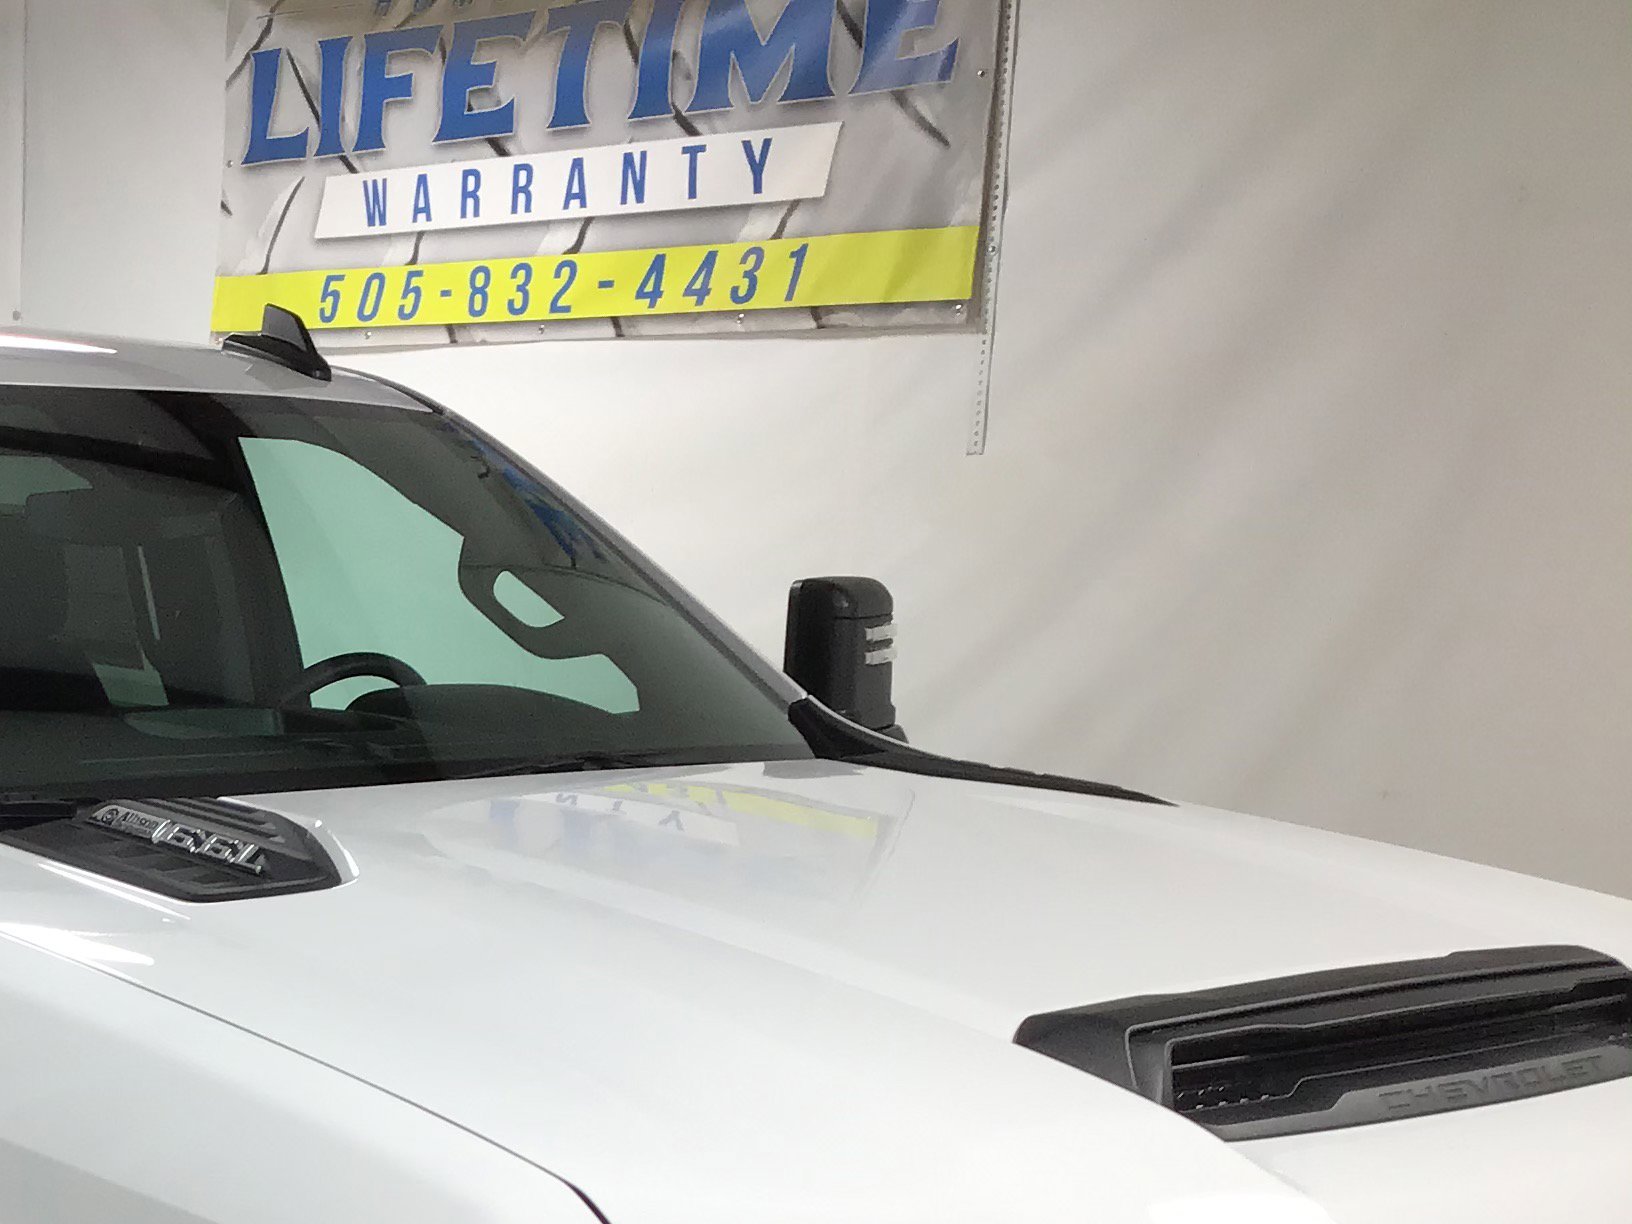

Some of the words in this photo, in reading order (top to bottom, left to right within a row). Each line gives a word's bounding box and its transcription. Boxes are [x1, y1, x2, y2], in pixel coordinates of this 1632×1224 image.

[241, 0, 960, 166] LIFETIME
[362, 137, 773, 228] WARRANTY
[319, 242, 809, 324] 505-832-4431
[1378, 1054, 1603, 1112] CHEVROLET
